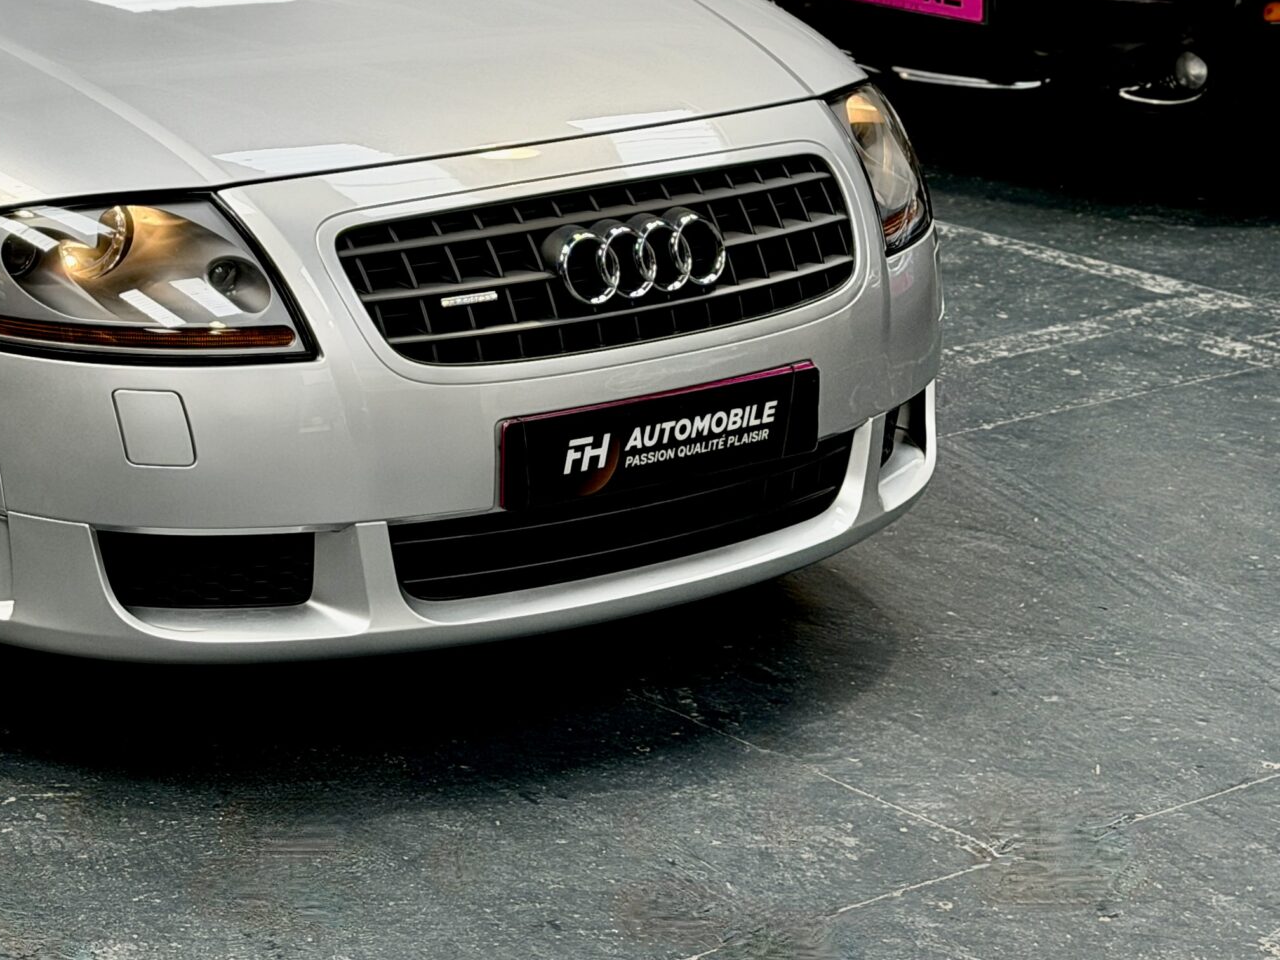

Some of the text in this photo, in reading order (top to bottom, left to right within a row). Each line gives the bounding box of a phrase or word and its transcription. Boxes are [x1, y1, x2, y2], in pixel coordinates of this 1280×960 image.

[563, 400, 778, 475] FH AUTOMOBILE
[624, 428, 770, 468] PASSION QUALITÉ PLAISIR
